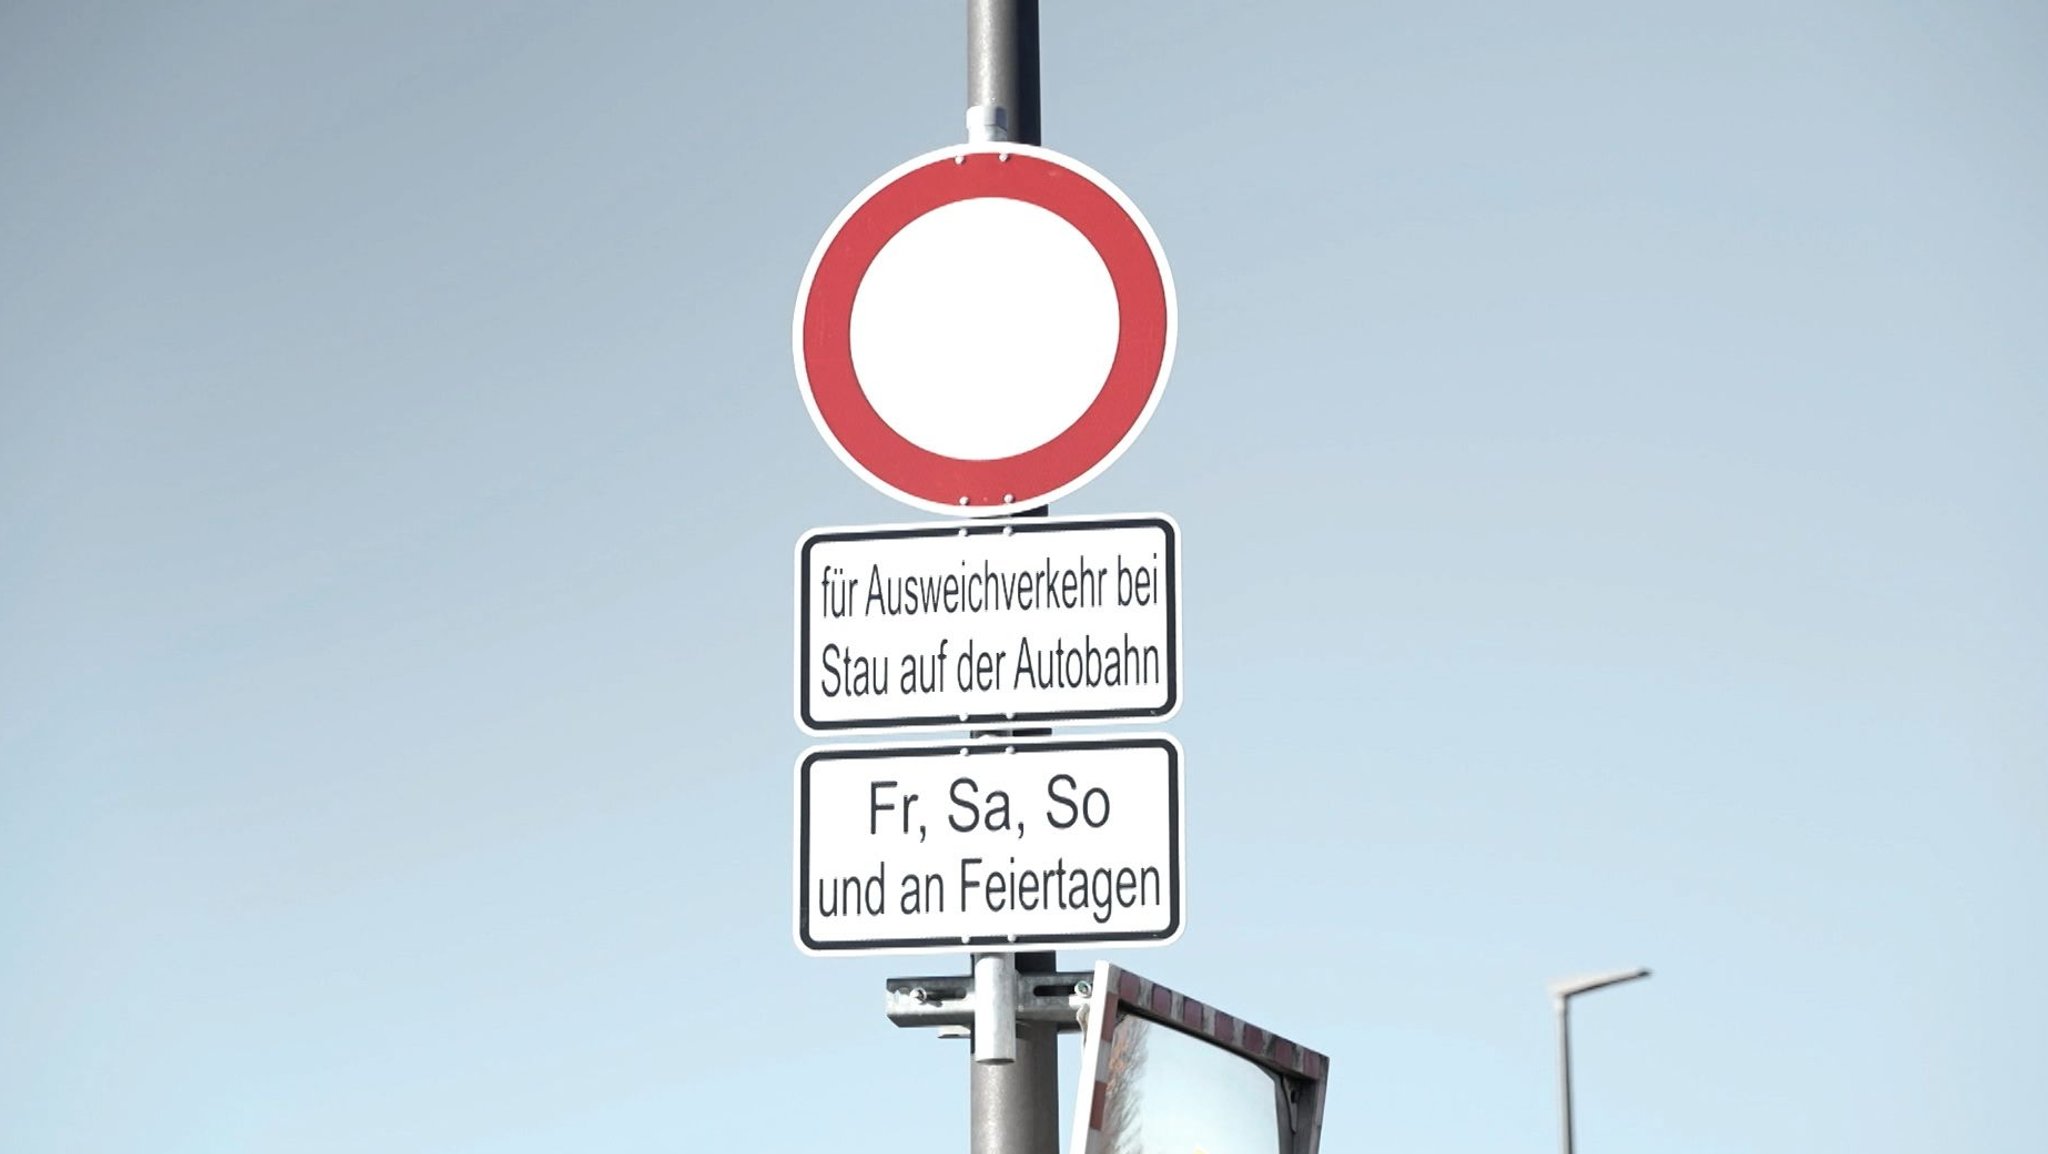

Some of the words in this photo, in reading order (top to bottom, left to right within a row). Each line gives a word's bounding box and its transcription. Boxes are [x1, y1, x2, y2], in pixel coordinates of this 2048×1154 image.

[821, 565, 859, 618] für
[865, 556, 1108, 616] Ausweichverkehr
[1117, 552, 1158, 607] bei
[821, 643, 888, 698] Stau
[900, 638, 948, 694] auf
[957, 639, 1007, 693] der
[1013, 634, 1160, 690] Autobahn
[870, 780, 927, 843] Fr,
[948, 777, 1025, 840] Sa,
[1046, 774, 1111, 829] So
[819, 861, 885, 918] und
[900, 873, 944, 915] an
[961, 857, 1160, 924] Feiertagen
